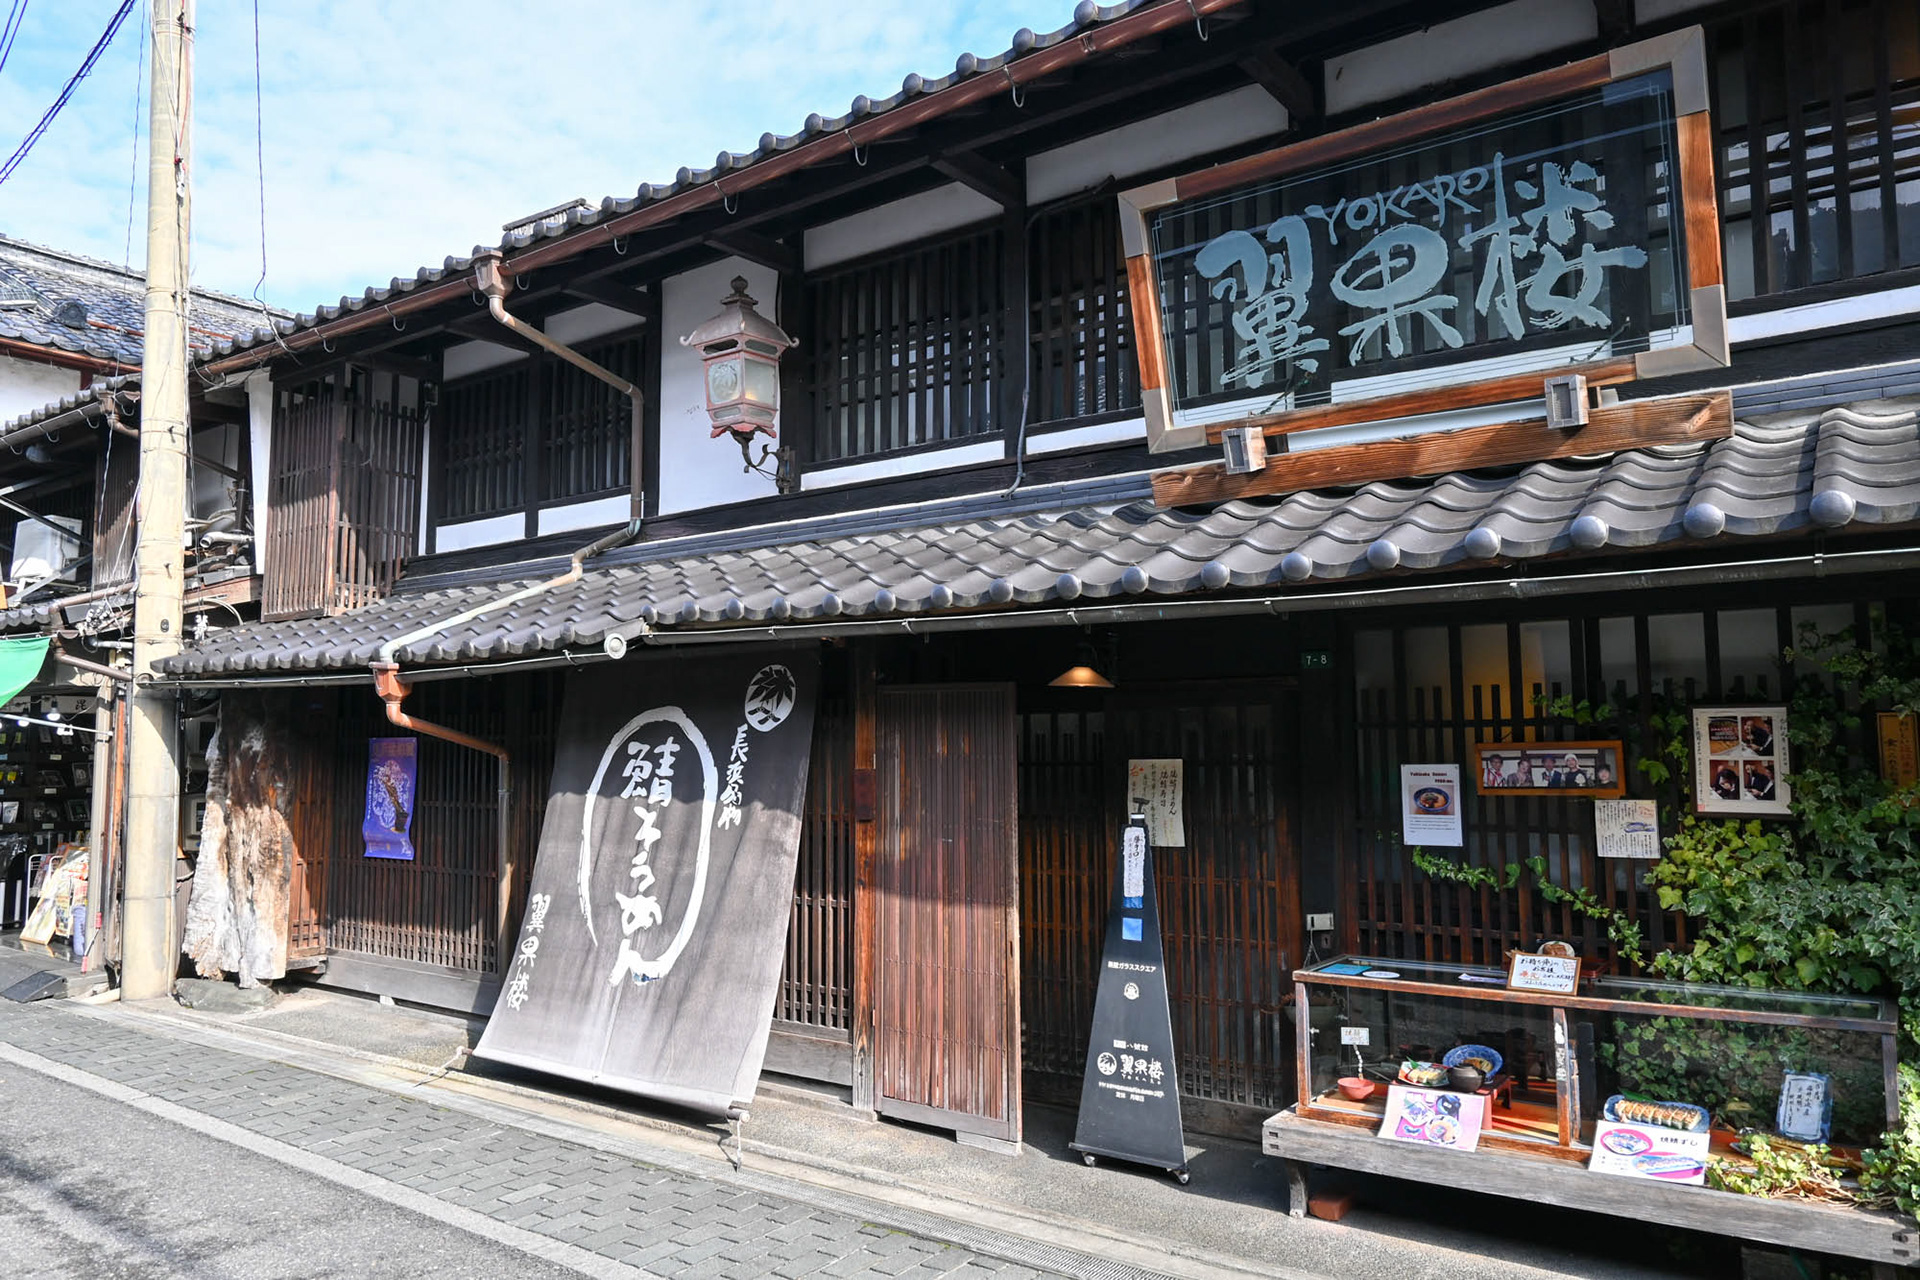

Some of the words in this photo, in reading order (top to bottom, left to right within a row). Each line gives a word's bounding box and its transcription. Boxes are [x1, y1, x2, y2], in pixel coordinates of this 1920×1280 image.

[1304, 166, 1489, 246] YOKARO
[1193, 151, 1649, 390] 翼果楼
[1305, 654, 1328, 666] 7-8
[718, 723, 749, 830] 長浜名物
[609, 736, 681, 987] 鯖そうめん
[508, 892, 551, 1012] 翼果楼
[1120, 1054, 1165, 1080] 翼果楼
